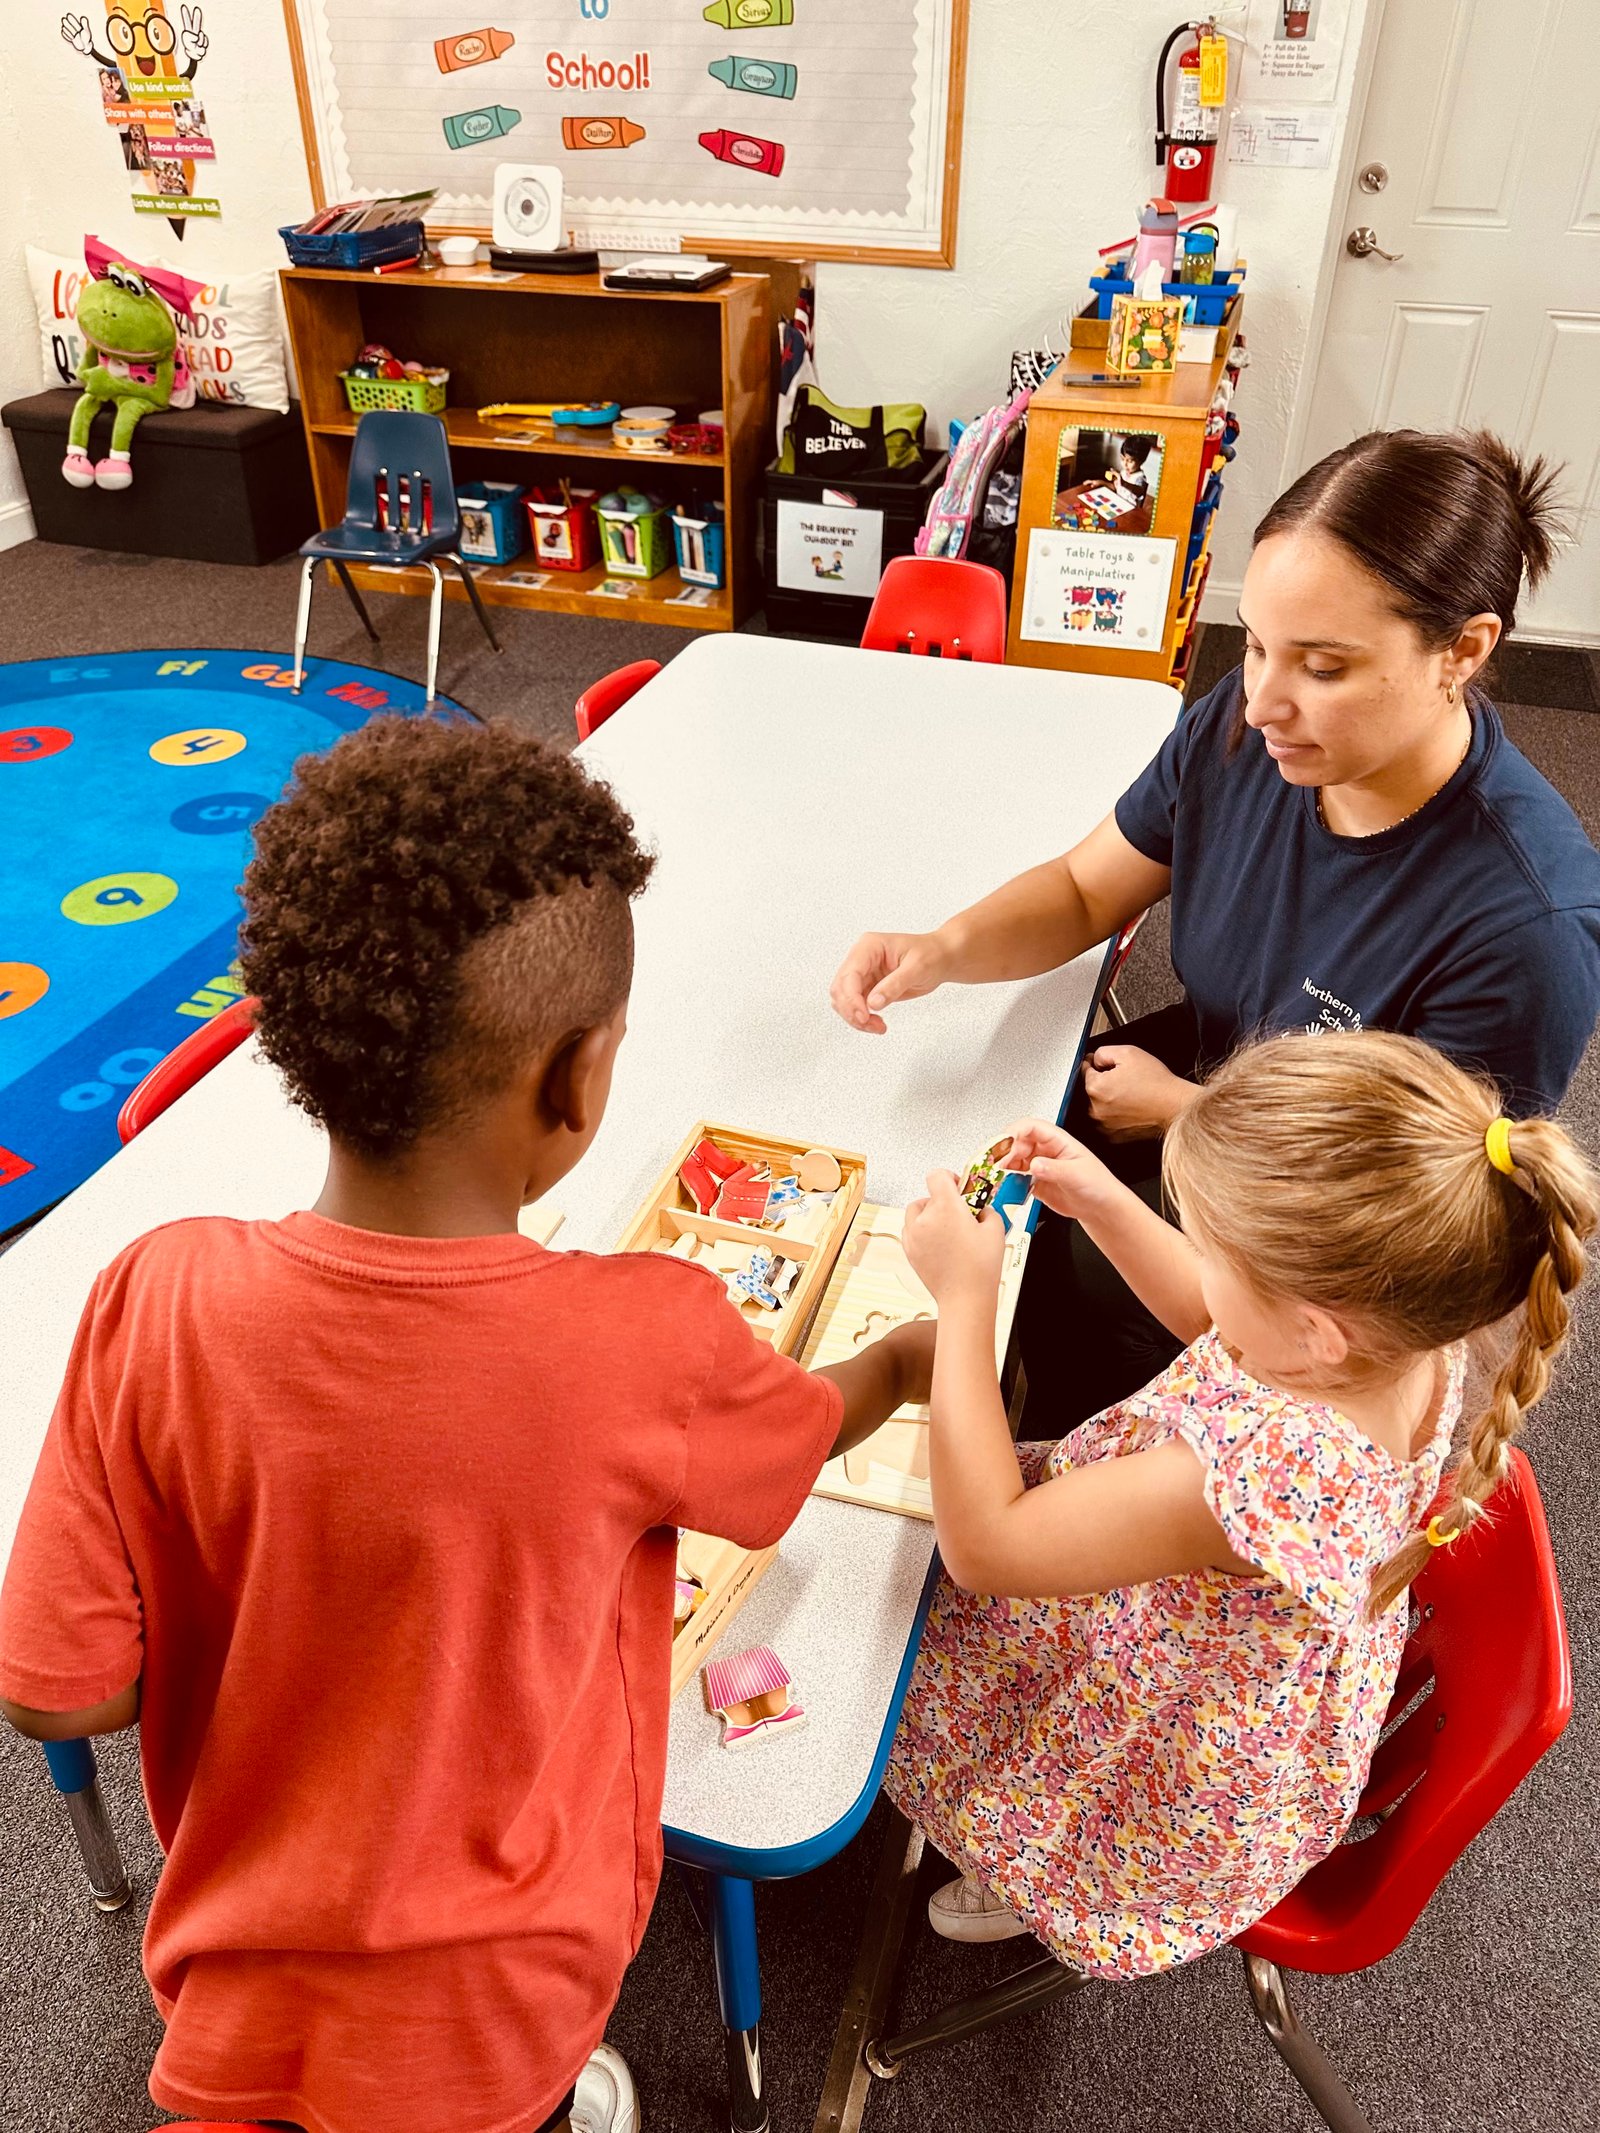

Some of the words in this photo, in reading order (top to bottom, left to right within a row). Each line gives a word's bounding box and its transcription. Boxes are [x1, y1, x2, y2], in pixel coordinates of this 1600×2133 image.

[546, 51, 650, 91] School!
[129, 82, 145, 92] Use
[145, 82, 164, 92] kind
[166, 82, 192, 93] words.
[104, 108, 127, 118] Share
[129, 108, 146, 119] with
[148, 109, 174, 120] others.
[148, 141, 172, 152] Follow
[174, 142, 214, 154] directions.
[134, 198, 154, 208] Listen
[156, 200, 177, 210] when
[178, 200, 203, 212] others
[187, 344, 233, 373] EAD
[829, 419, 853, 436] THE
[1065, 547, 1095, 560] Table
[1099, 550, 1123, 565] Toys
[1126, 552, 1135, 562] &
[1060, 565, 1136, 581] Manipulatives
[156, 660, 209, 676] Ff
[240, 663, 307, 688] Gg
[325, 681, 389, 709] Hh
[11, 735, 43, 752] 3
[181, 735, 227, 756] 4
[198, 805, 252, 821] 5
[1301, 977, 1354, 1017] Northern
